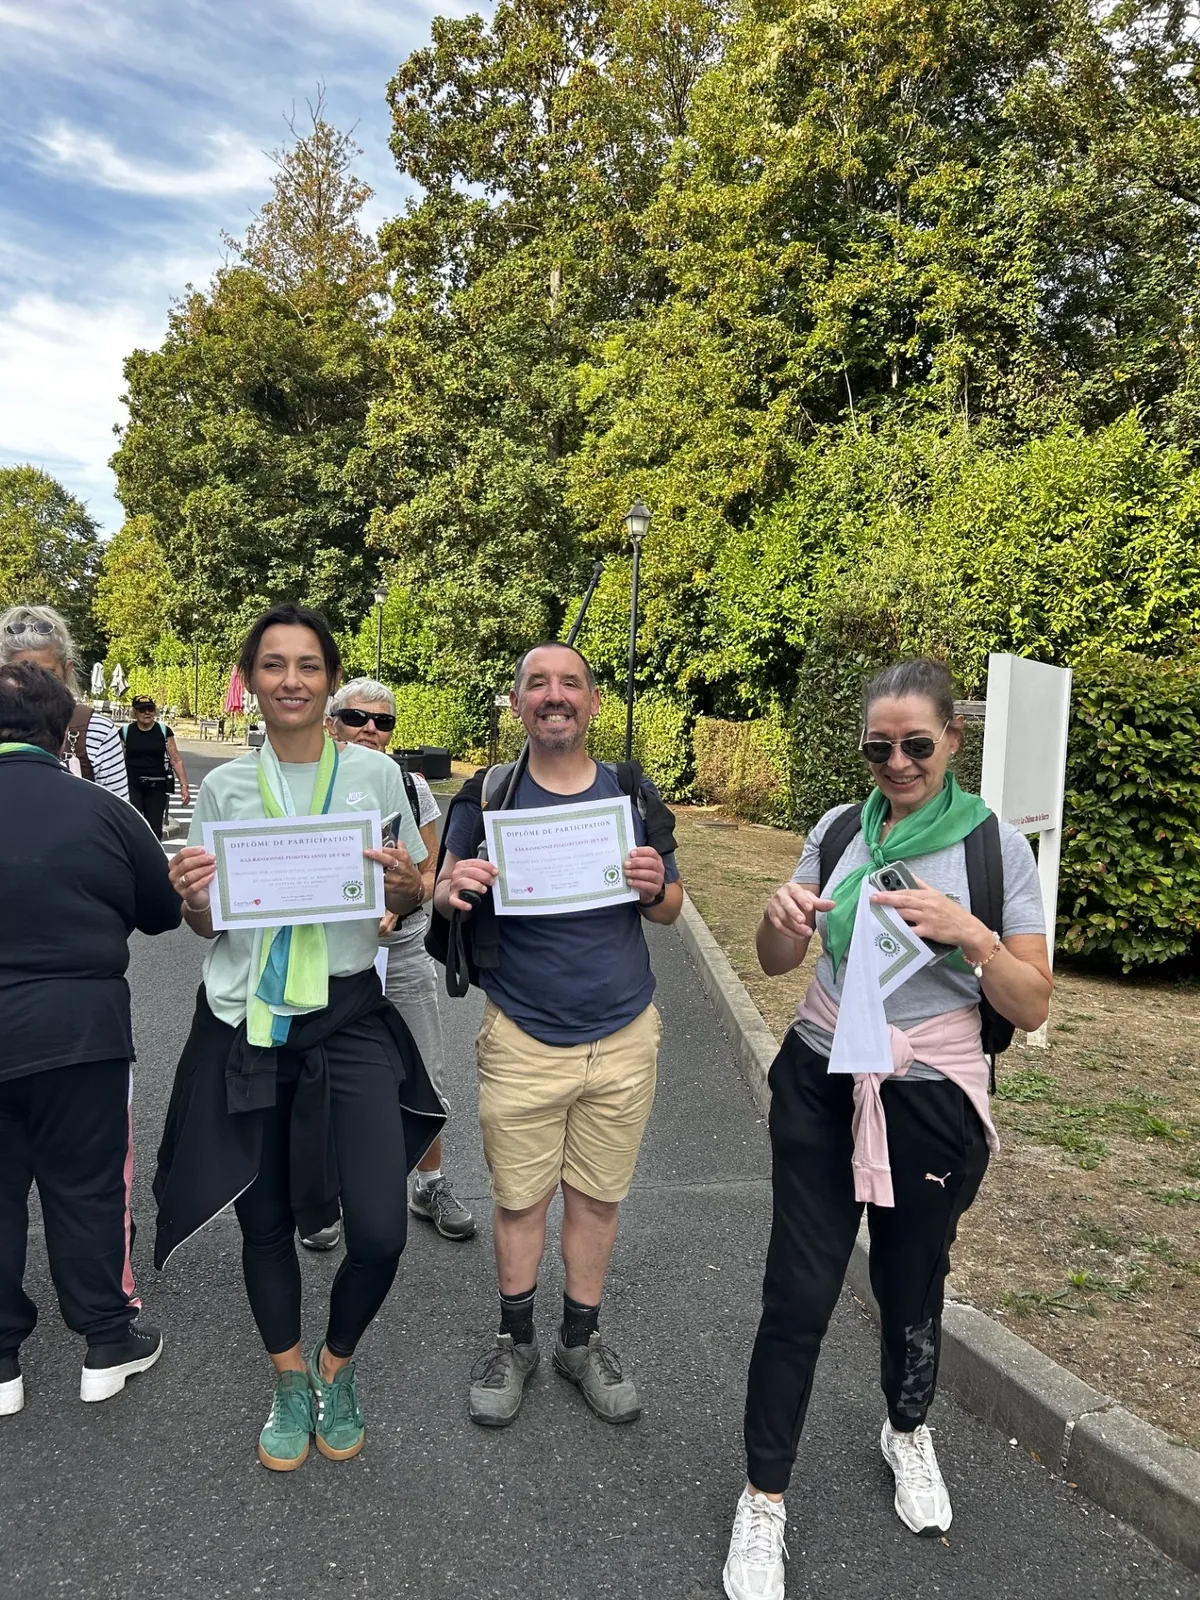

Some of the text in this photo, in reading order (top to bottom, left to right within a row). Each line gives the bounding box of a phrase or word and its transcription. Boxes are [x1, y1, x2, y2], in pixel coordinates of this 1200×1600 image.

[348, 791, 364, 801] NIKE
[506, 829, 540, 837] DIPLÔME
[555, 820, 611, 833] PARTICIPATION
[230, 840, 268, 849] DIPLÔME
[287, 835, 355, 845] PARTICIPATION
